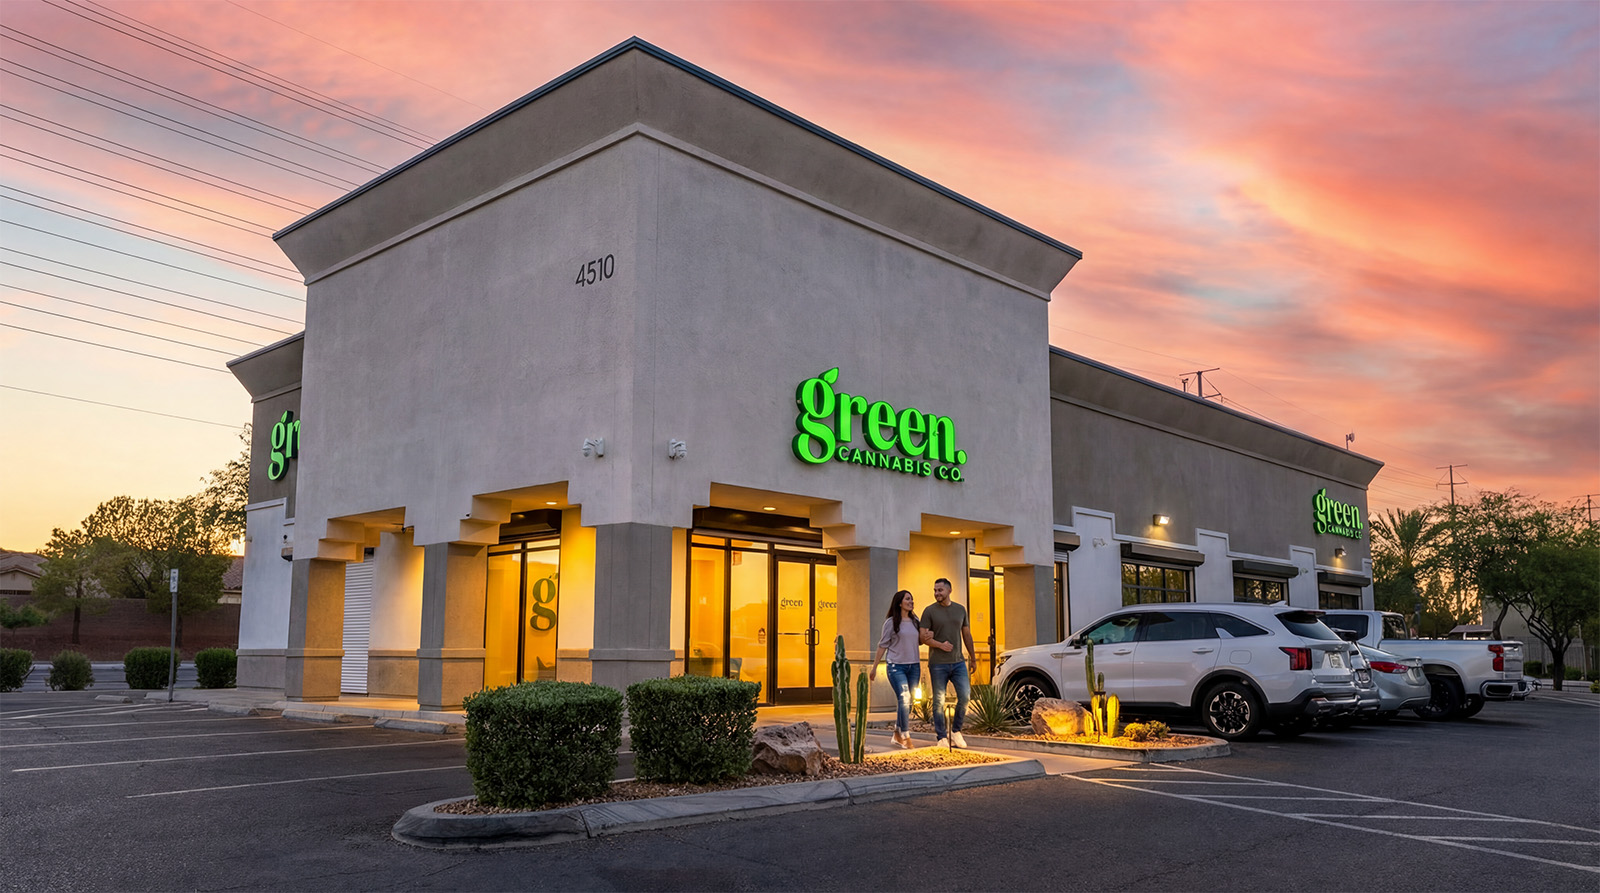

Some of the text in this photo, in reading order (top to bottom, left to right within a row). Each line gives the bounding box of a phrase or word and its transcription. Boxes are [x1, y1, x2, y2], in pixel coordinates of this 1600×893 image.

[575, 253, 615, 287] 4510
[267, 410, 300, 481] gr
[835, 446, 932, 477] CANNABIS
